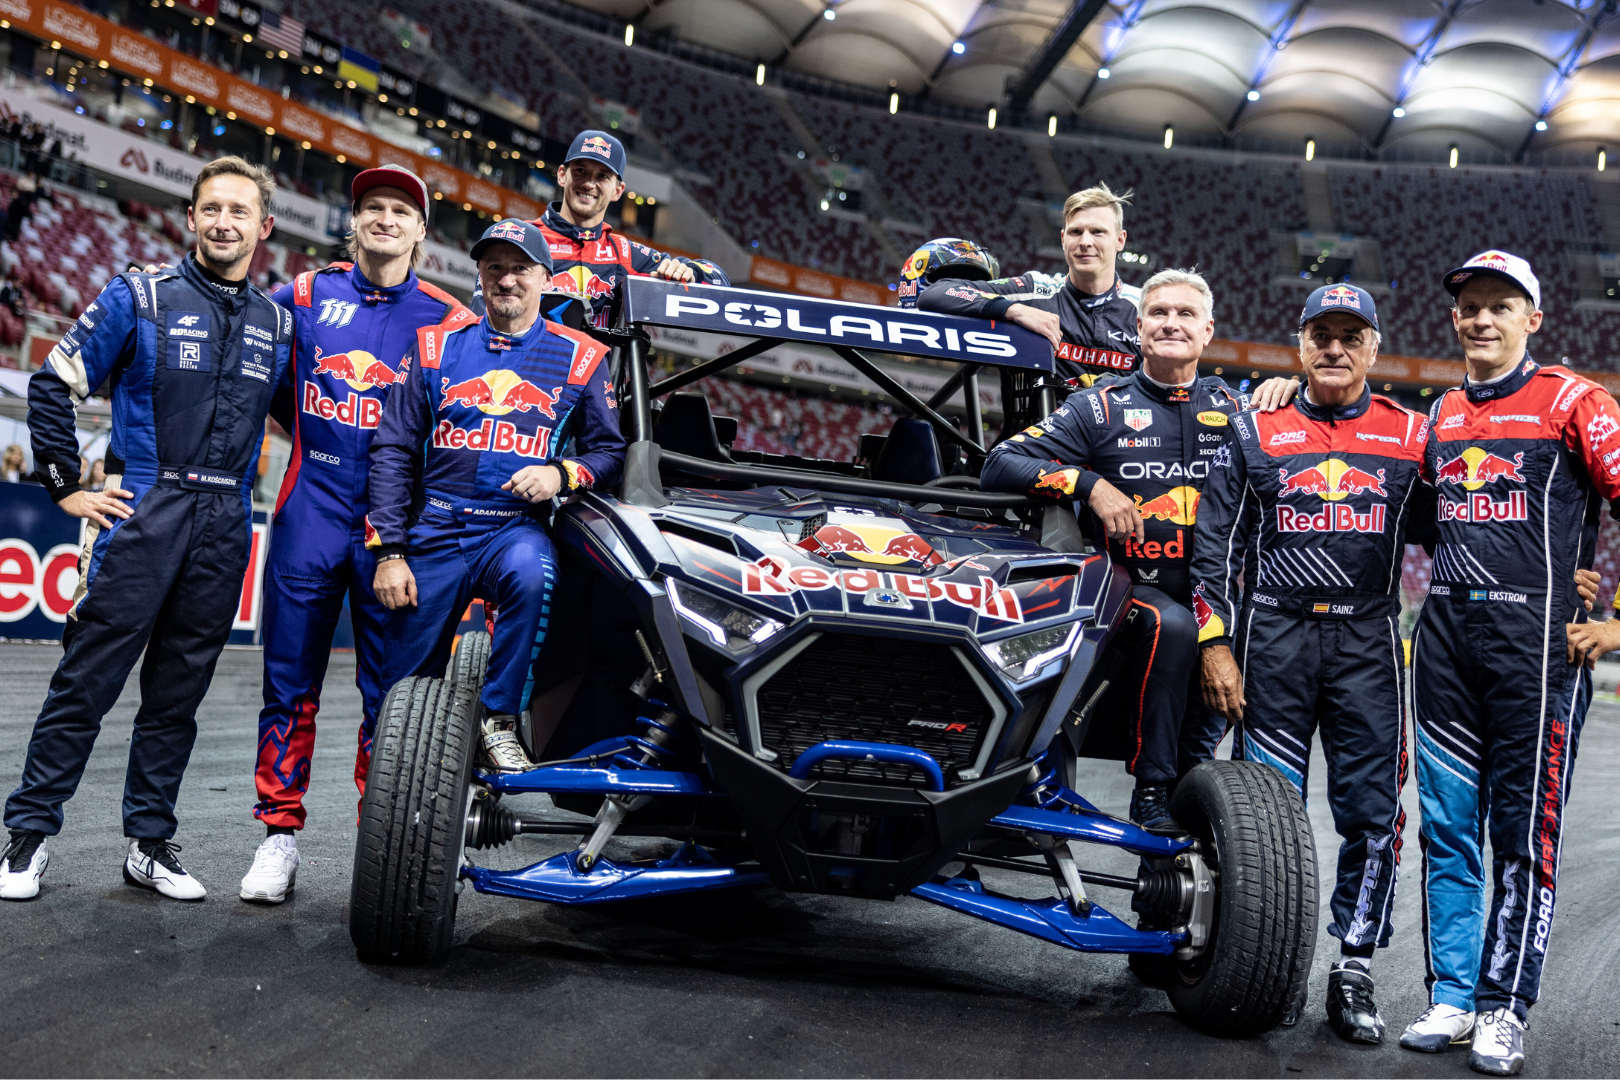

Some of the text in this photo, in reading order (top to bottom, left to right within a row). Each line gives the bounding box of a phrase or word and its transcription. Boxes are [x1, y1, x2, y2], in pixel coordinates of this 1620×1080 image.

[581, 145, 611, 159] Red Bull
[506, 231, 525, 242] Bull
[130, 276, 149, 309] sparco
[945, 287, 977, 302] Red Bull
[1321, 297, 1360, 309] Red Bull
[177, 315, 200, 327] 4F
[665, 294, 1018, 357] POLARIS
[425, 331, 436, 361] sparco
[574, 347, 597, 378] sparco
[1057, 345, 1135, 369] AUHAUS
[303, 380, 358, 427] Red
[1559, 382, 1590, 412] sparco
[1087, 393, 1104, 424] sparco
[1125, 410, 1150, 418] TAG
[1205, 415, 1226, 423] RAUCH
[1490, 415, 1542, 426] RAPTOR
[1234, 415, 1251, 441] sparco
[1270, 430, 1307, 442] FORD
[1416, 418, 1429, 444] sparco
[433, 418, 552, 460] Red Bull
[1117, 437, 1149, 448] Mobil
[1269, 437, 1307, 446] PERFORMANCE
[1356, 432, 1403, 449] RAPTOR
[309, 449, 341, 466] sparco
[473, 508, 496, 516] ADAM
[1437, 490, 1528, 523] Red Bull
[1276, 503, 1387, 534] Red Bull
[1125, 529, 1184, 560] Red
[741, 556, 1024, 624] Red Bull
[1251, 592, 1278, 605] sparco
[1430, 585, 1450, 596] sparco
[1331, 604, 1354, 615] SAINZ
[907, 719, 948, 730] PRO
[1533, 718, 1566, 954] FORD PERFORMANCE
